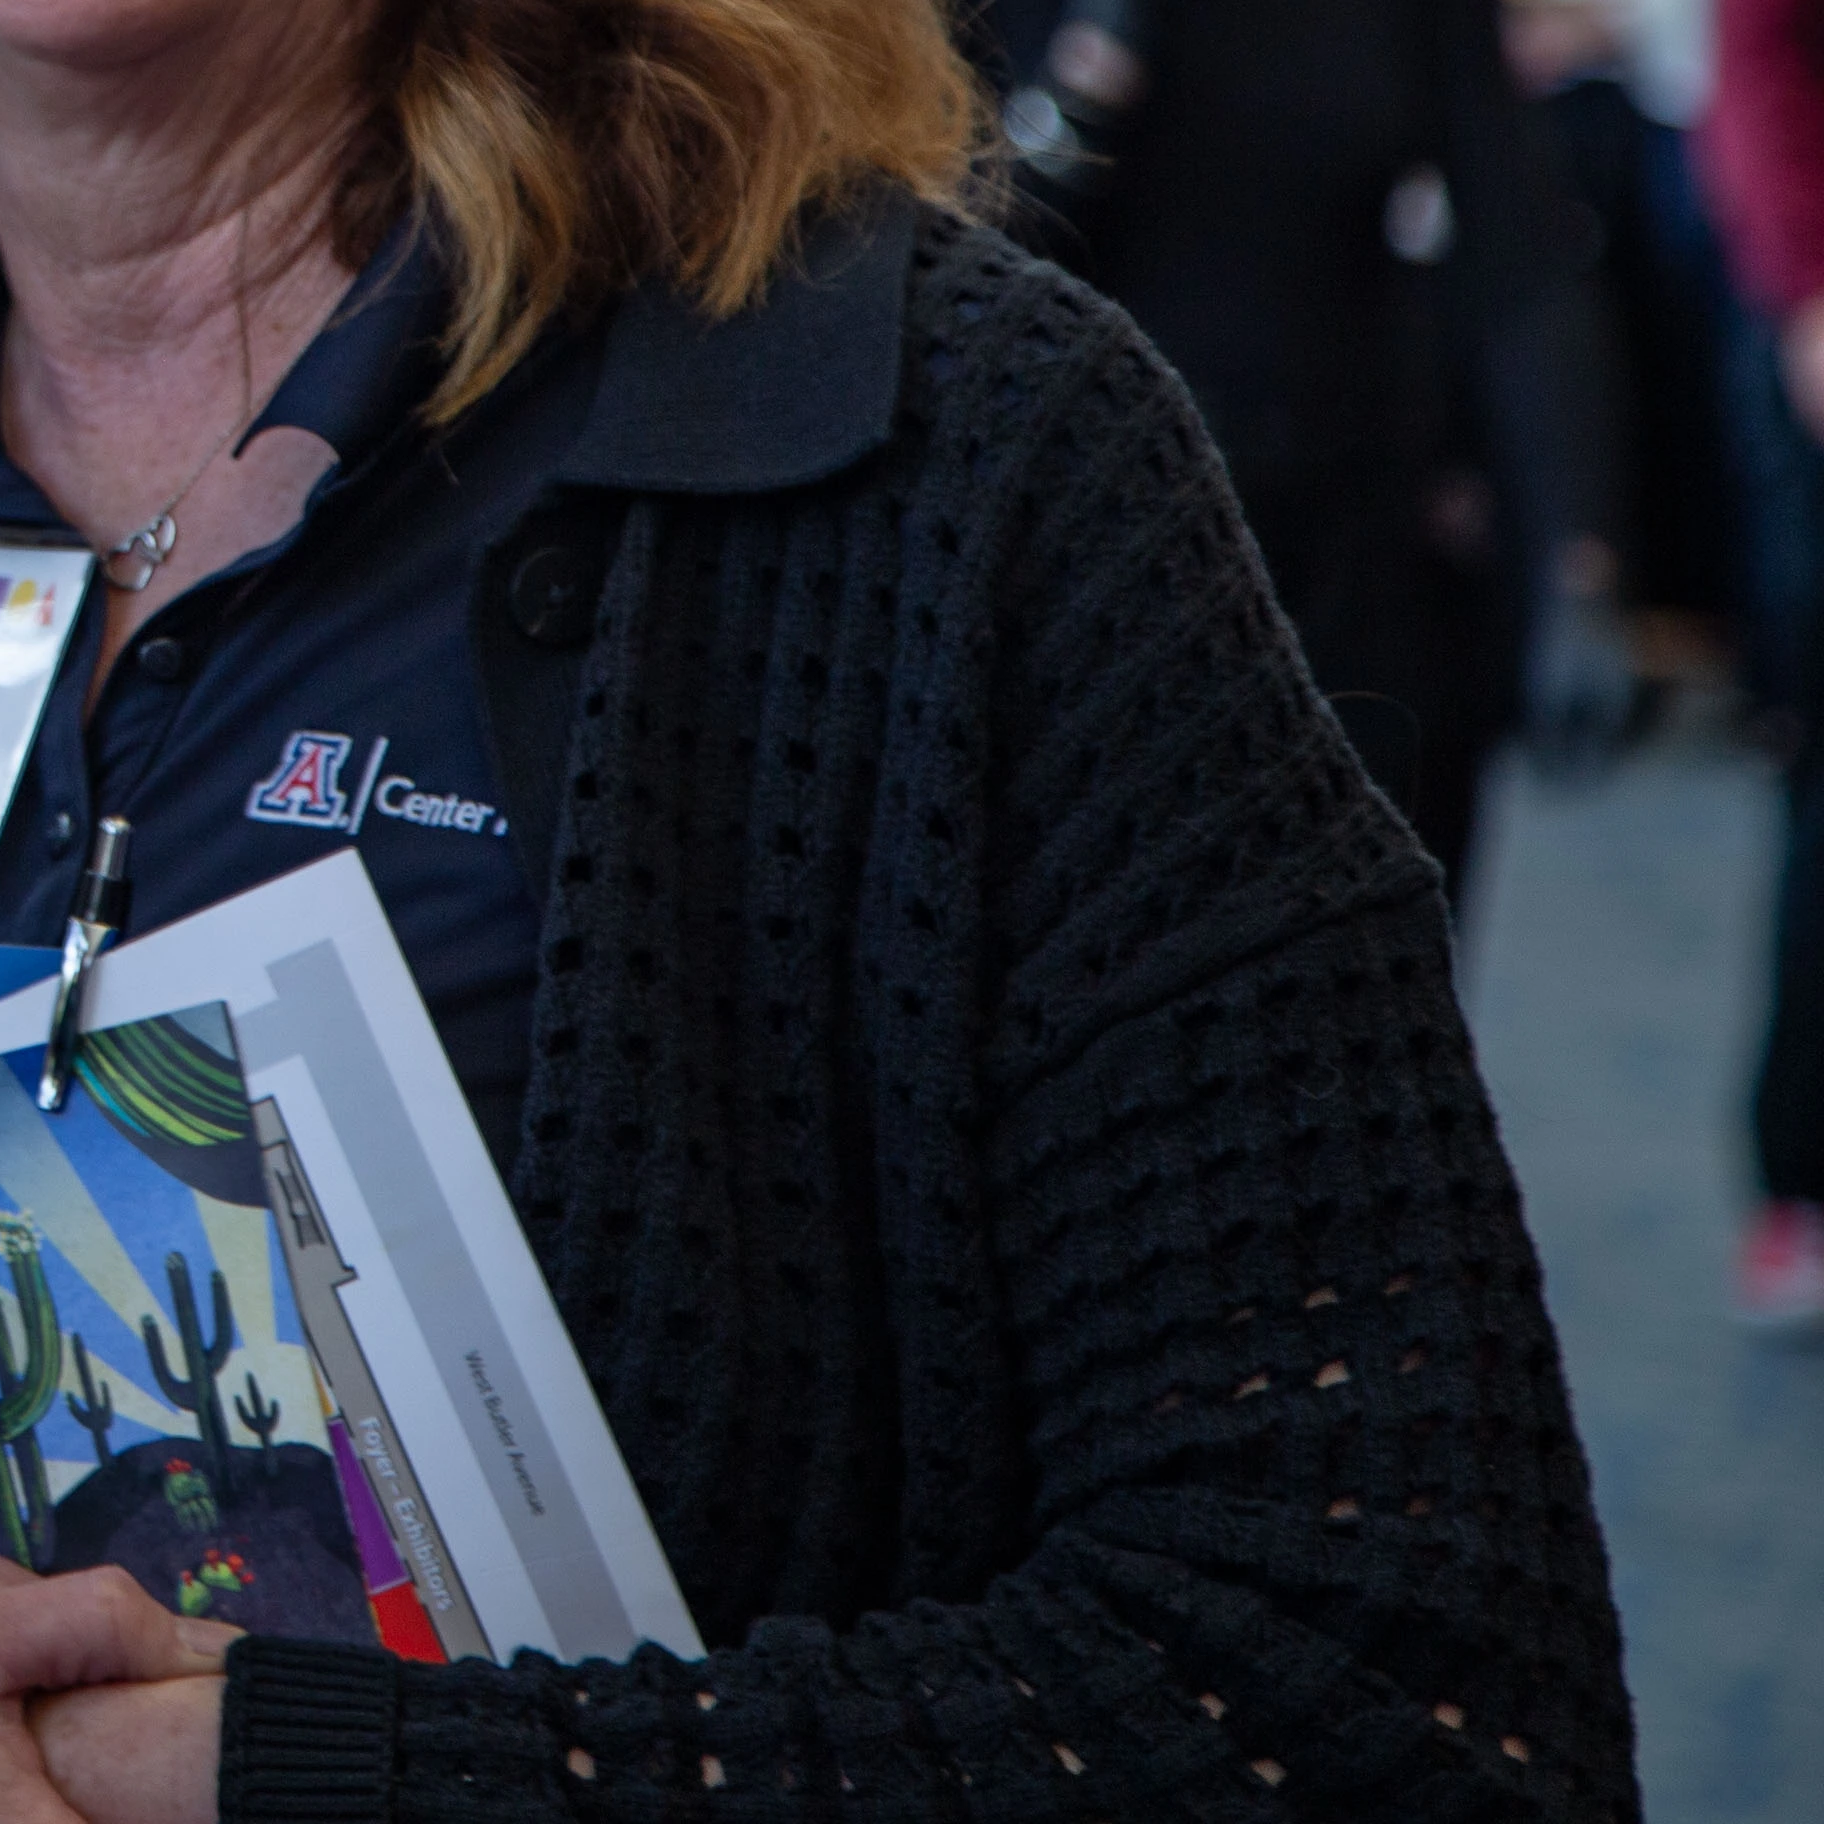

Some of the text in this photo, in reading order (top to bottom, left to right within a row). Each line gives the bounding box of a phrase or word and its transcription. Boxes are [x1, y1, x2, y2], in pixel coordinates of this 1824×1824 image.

[375, 775, 496, 835] Center
[359, 1417, 397, 1478] Foyer
[393, 1498, 454, 1611] Exhibitors
[506, 1451, 545, 1517] Avenue
